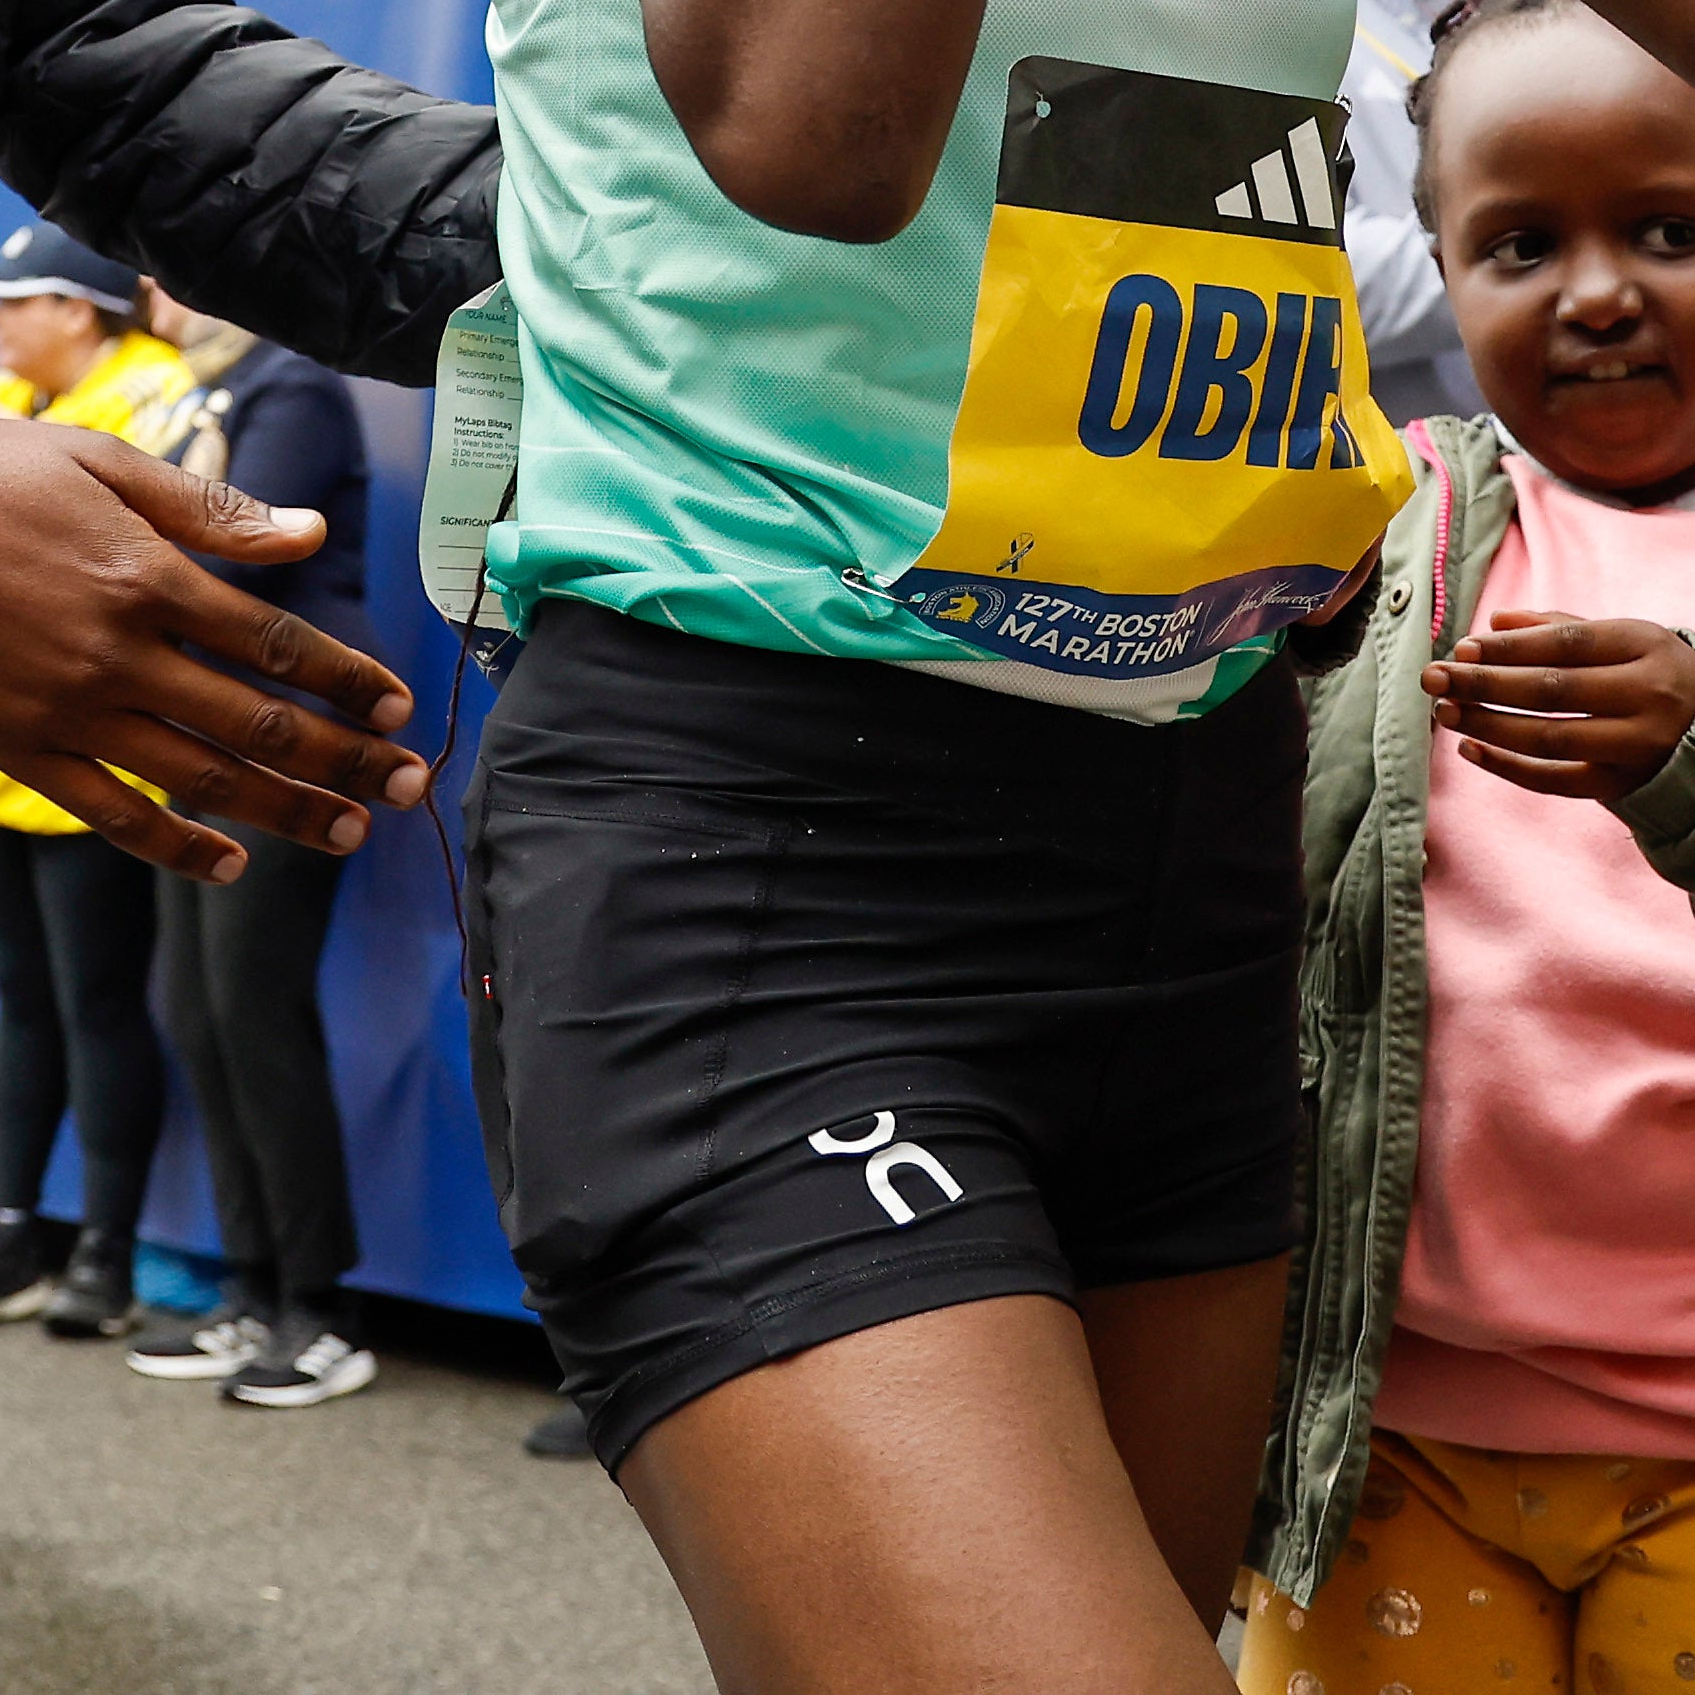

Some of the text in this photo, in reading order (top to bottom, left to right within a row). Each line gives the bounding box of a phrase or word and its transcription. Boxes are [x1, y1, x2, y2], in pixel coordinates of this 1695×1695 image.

[459, 330, 489, 344] Primary
[457, 346, 505, 362] Relationship
[456, 368, 498, 383] Secondary
[1077, 272, 1367, 472] OBIR
[456, 384, 505, 399] Relationship
[454, 416, 513, 431] MyLaps Bibtag
[453, 427, 505, 440] Instructions:
[460, 449, 471, 457] Do
[472, 450, 484, 459] not
[458, 459, 470, 468] Do
[1014, 592, 1204, 638] 127TH BOSTON
[997, 613, 1192, 665] MARATHON
